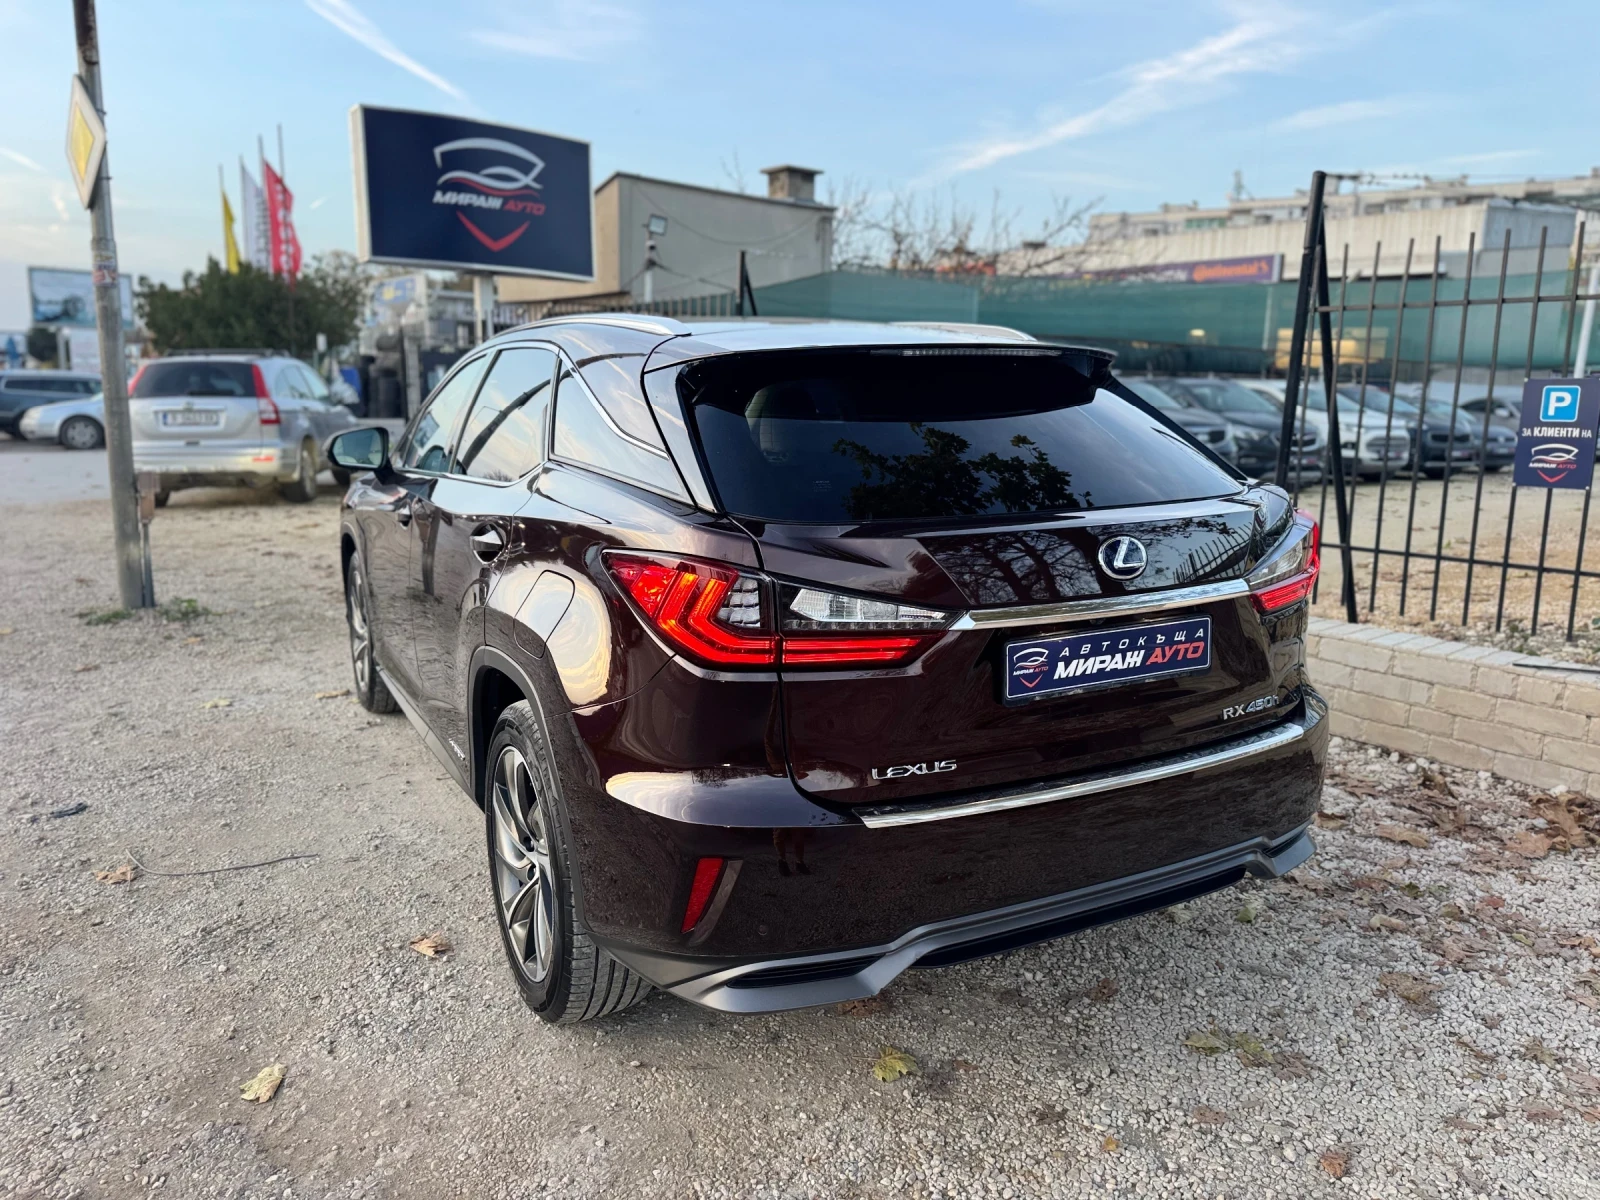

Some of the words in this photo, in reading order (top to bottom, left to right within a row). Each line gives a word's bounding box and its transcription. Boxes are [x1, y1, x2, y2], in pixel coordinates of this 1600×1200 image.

[432, 189, 503, 210] МИРАЖ
[504, 201, 546, 216] АУТО
[1547, 391, 1572, 416] P
[1521, 427, 1532, 437] ЗА
[1533, 426, 1580, 438] КЛИЕНТИ
[1581, 429, 1592, 438] НА
[1053, 650, 1145, 680] МИРАЖ
[1146, 641, 1205, 666] АУТО
[1223, 704, 1245, 720] RX
[1246, 695, 1279, 713] 450h
[871, 759, 957, 780] LEXUS
